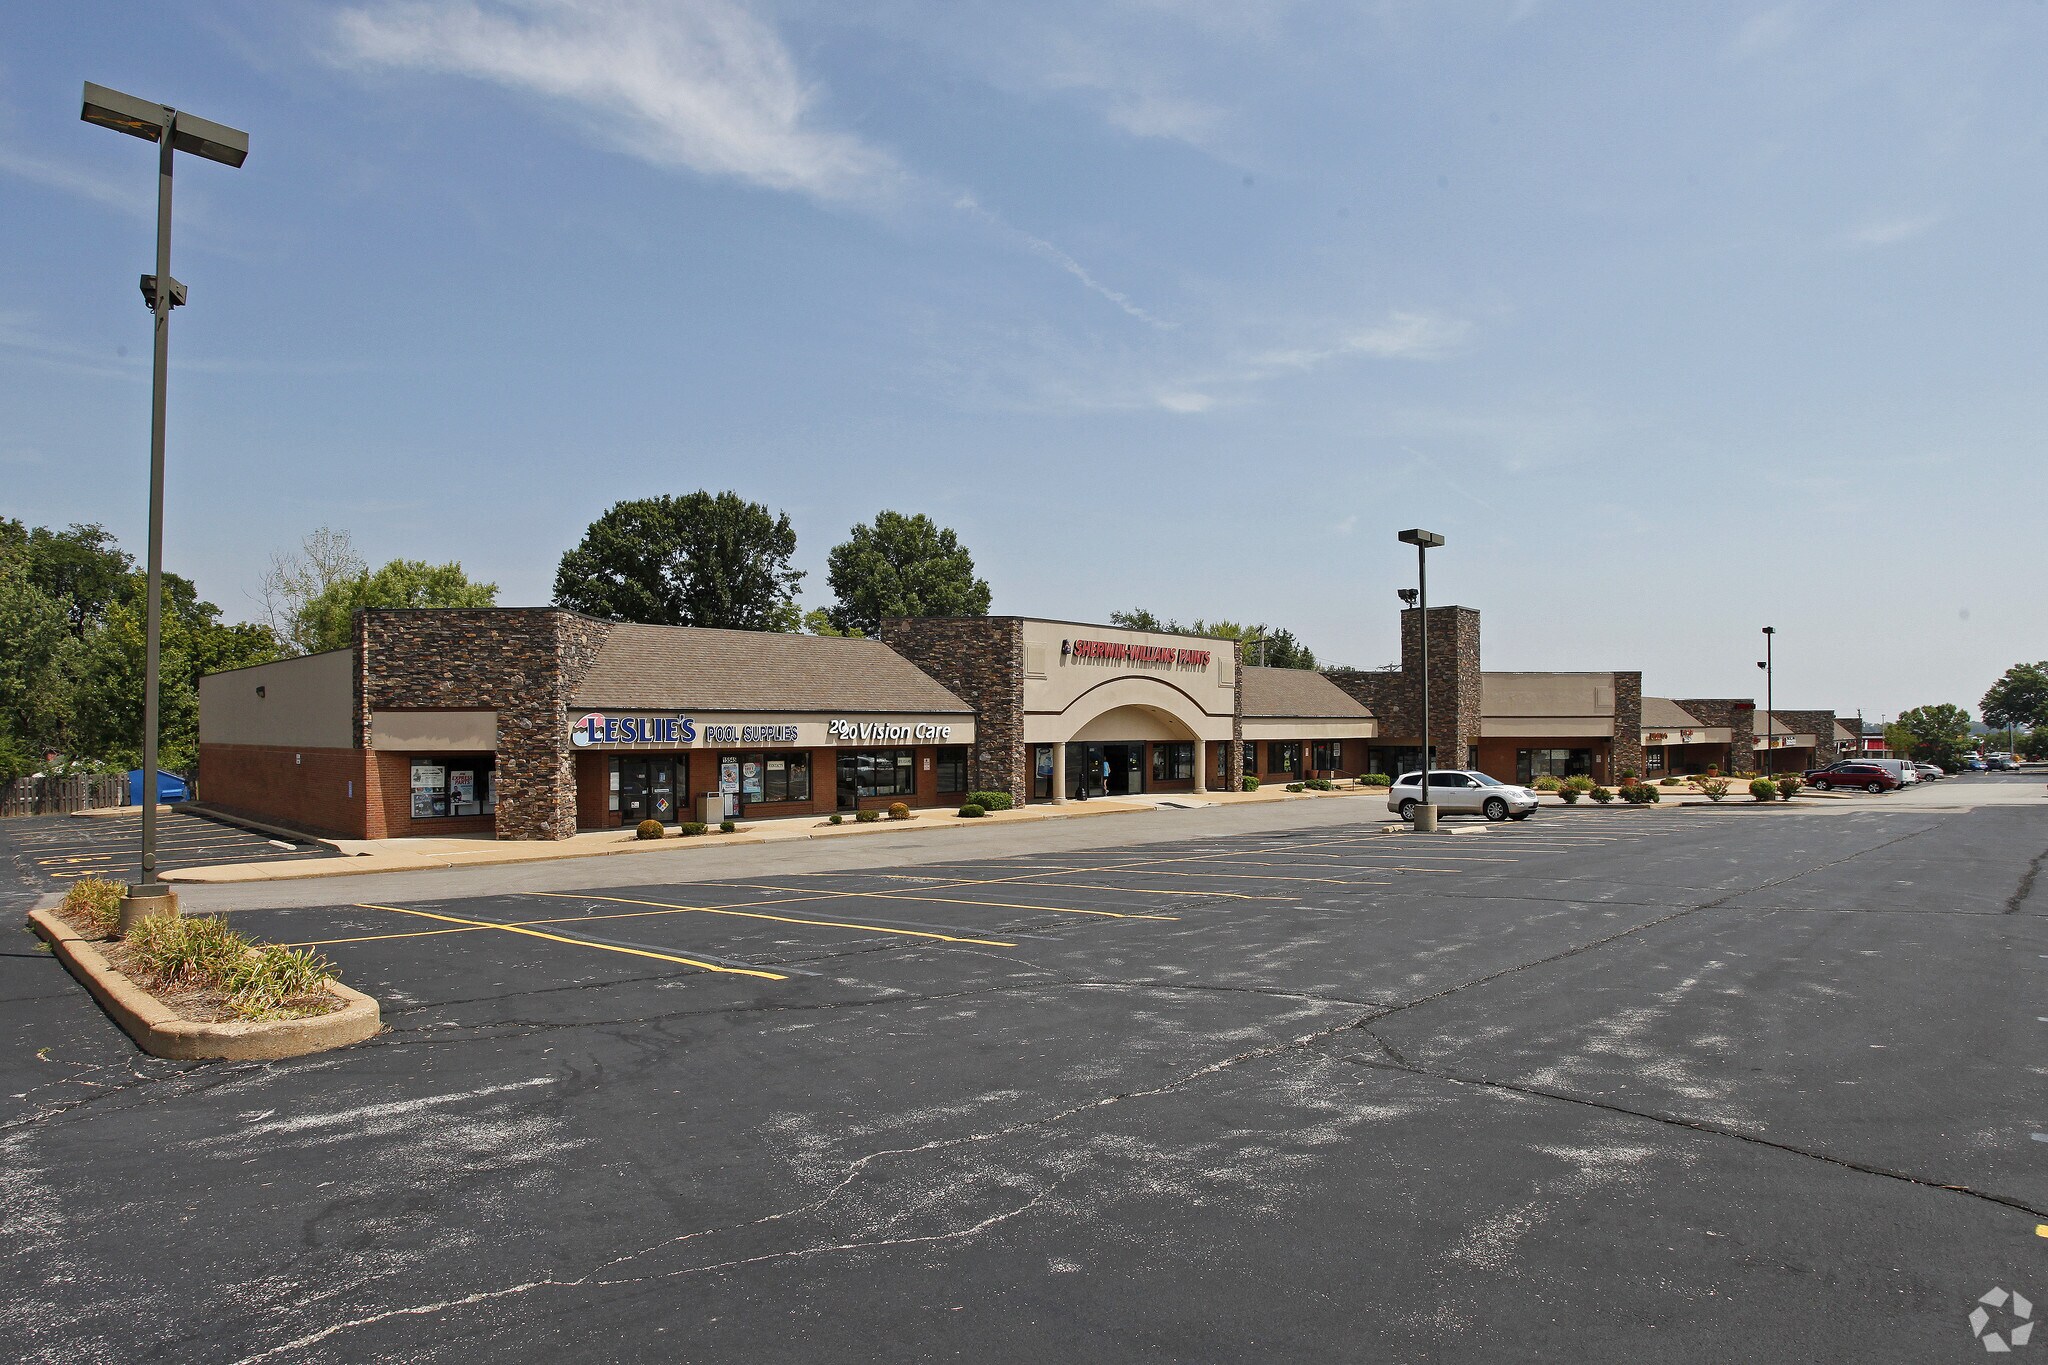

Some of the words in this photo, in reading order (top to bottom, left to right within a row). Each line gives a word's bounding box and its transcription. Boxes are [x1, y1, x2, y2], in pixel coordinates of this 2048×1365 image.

[1075, 640, 1177, 662] SHERWIN-WILLIAMS
[1178, 648, 1211, 666] PAINTS
[587, 714, 697, 743] LESLIE'S
[706, 726, 740, 742] POOL
[742, 724, 799, 742] SUPPLIES
[859, 722, 911, 739] Vision
[916, 723, 951, 739] Care
